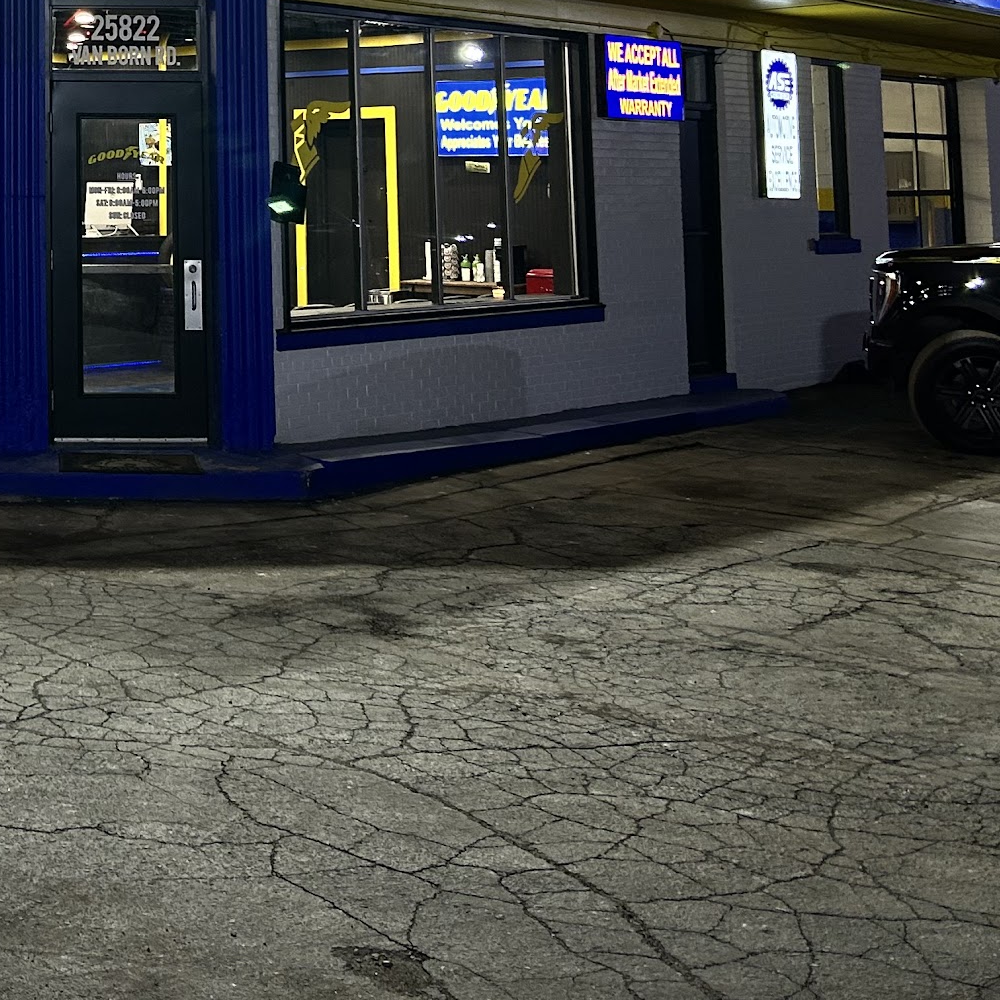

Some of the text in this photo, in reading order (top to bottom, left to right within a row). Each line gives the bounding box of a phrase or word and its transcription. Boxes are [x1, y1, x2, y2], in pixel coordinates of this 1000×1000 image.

[90, 14, 160, 41] 25822
[71, 44, 181, 66] VAN BORN RD.
[607, 41, 680, 68] WE ACCEPT ALL
[768, 71, 790, 92] ASE
[619, 97, 673, 117] WARRANTY
